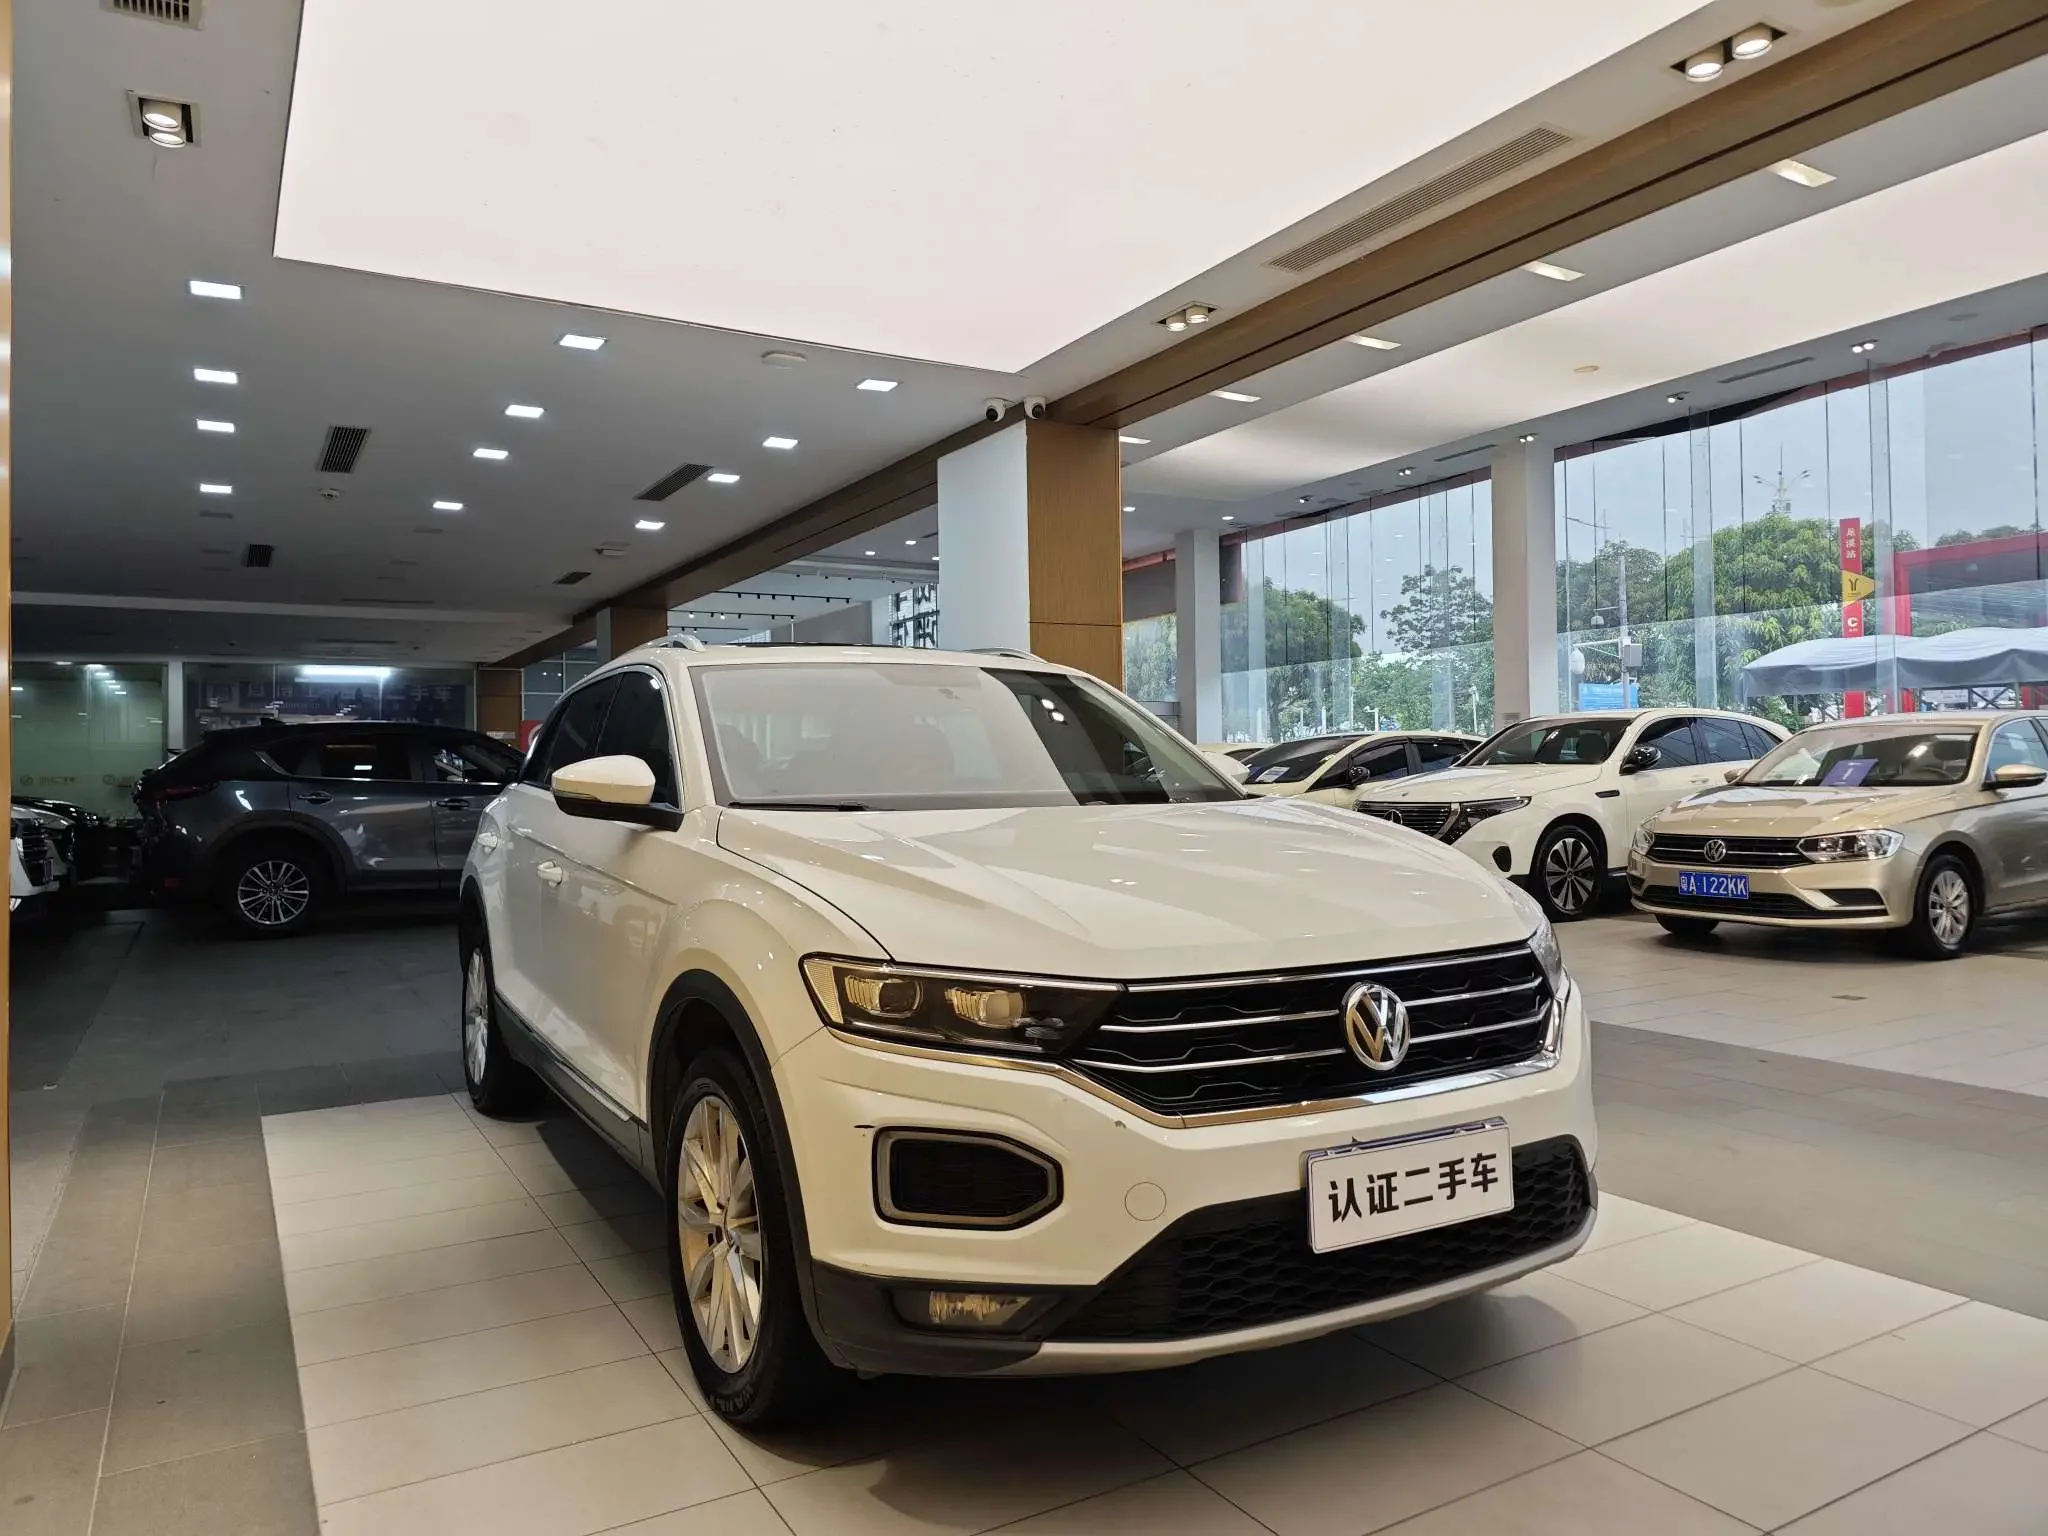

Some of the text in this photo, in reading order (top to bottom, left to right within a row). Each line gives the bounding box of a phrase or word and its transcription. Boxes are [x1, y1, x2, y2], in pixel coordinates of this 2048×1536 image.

[1328, 1152, 1498, 1223] 认证二手车
